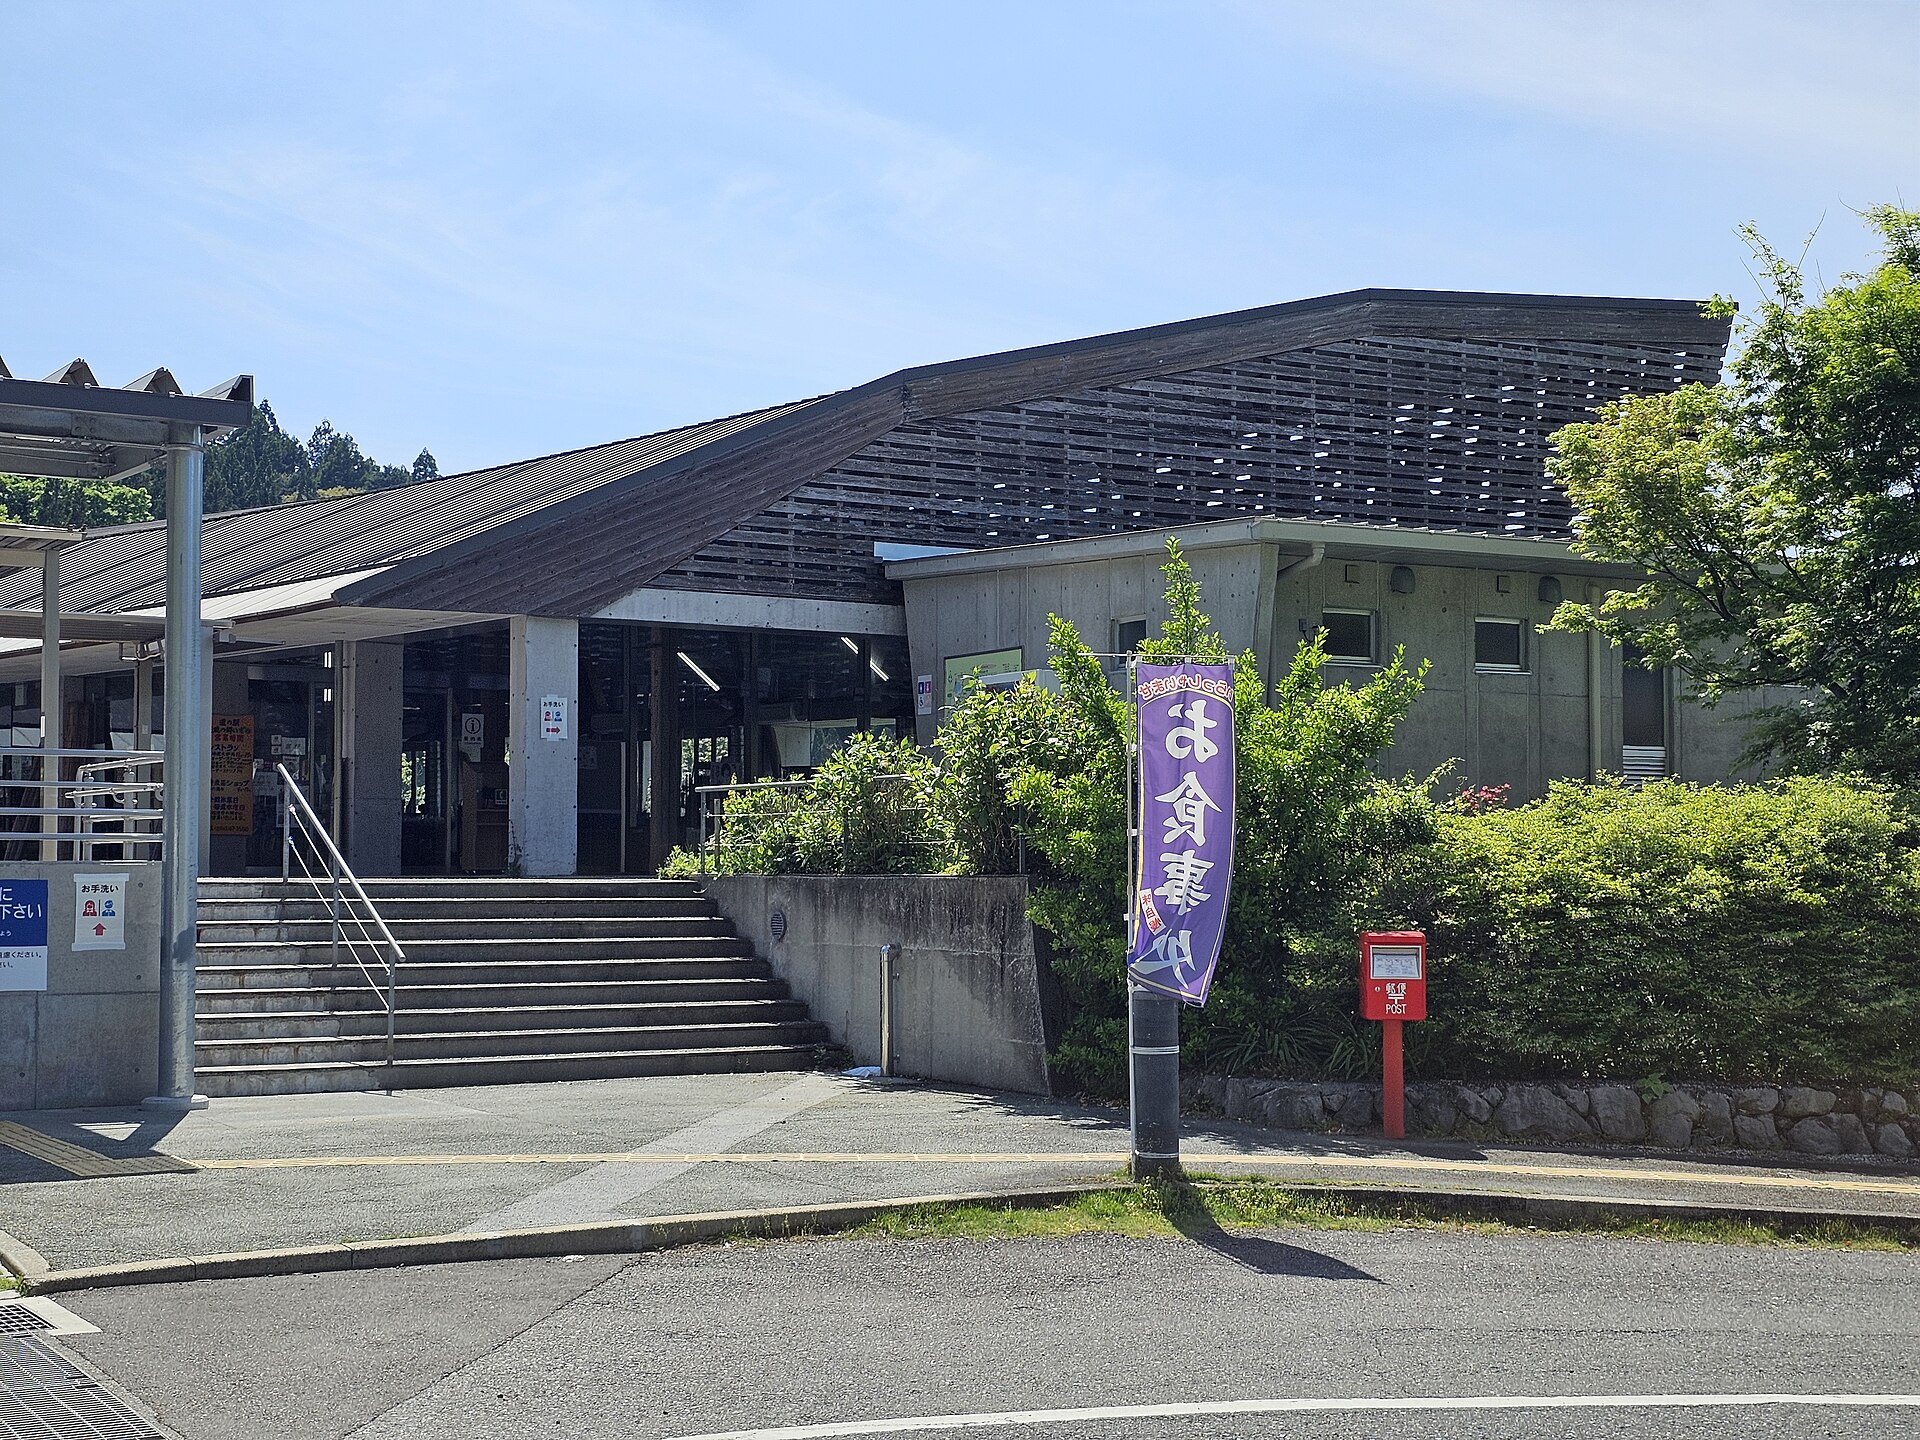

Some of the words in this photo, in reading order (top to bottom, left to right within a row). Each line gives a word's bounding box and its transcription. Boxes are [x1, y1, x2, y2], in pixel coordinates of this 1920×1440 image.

[81, 884, 119, 894] お手洗い
[1385, 983, 1407, 995] 郵便
[1385, 1004, 1407, 1015] POST
